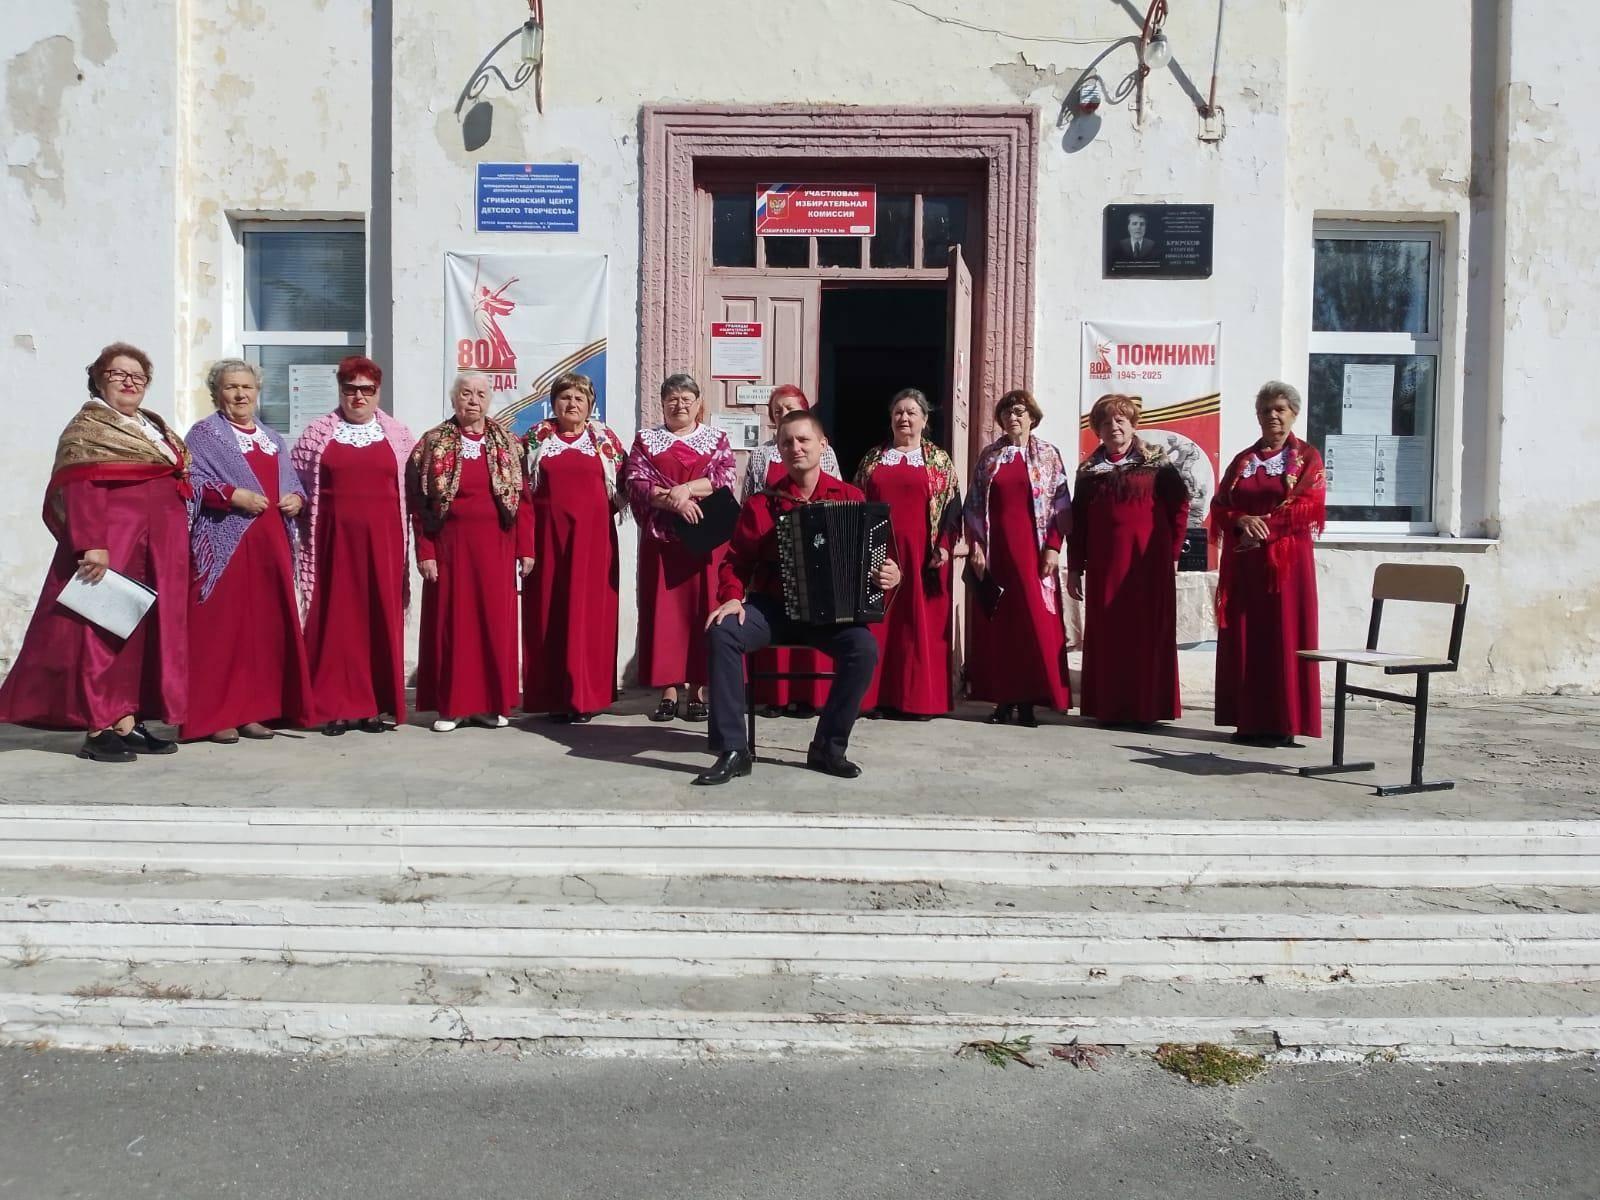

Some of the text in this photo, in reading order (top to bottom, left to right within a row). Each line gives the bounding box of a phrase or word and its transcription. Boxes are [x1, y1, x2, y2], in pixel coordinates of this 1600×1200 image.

[795, 200, 868, 208] ИЗБИРАТЕЛЬНАЯ
[457, 338, 490, 368] 80
[1117, 344, 1216, 366] ПОМНИМ!
